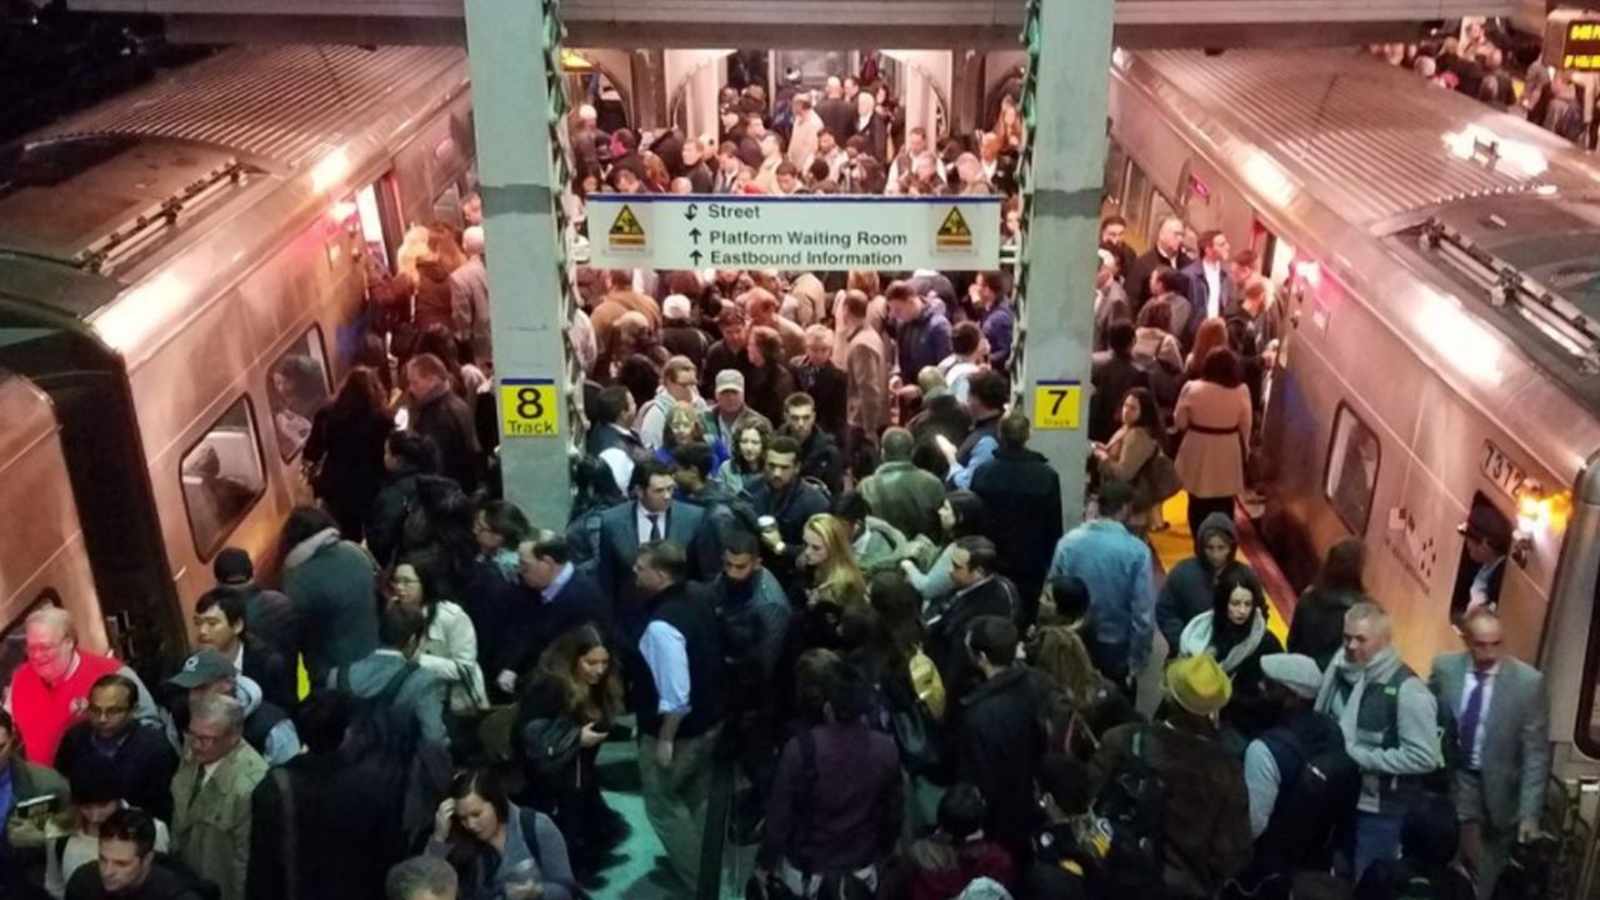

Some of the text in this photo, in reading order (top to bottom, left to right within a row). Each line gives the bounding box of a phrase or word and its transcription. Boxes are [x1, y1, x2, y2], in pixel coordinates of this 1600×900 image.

[708, 204, 760, 219] Street
[709, 231, 908, 248] Platform Waiting Room
[711, 250, 903, 266] Eastbound Information
[516, 387, 544, 419] 8
[1048, 389, 1069, 417] 7
[507, 420, 554, 434] Track
